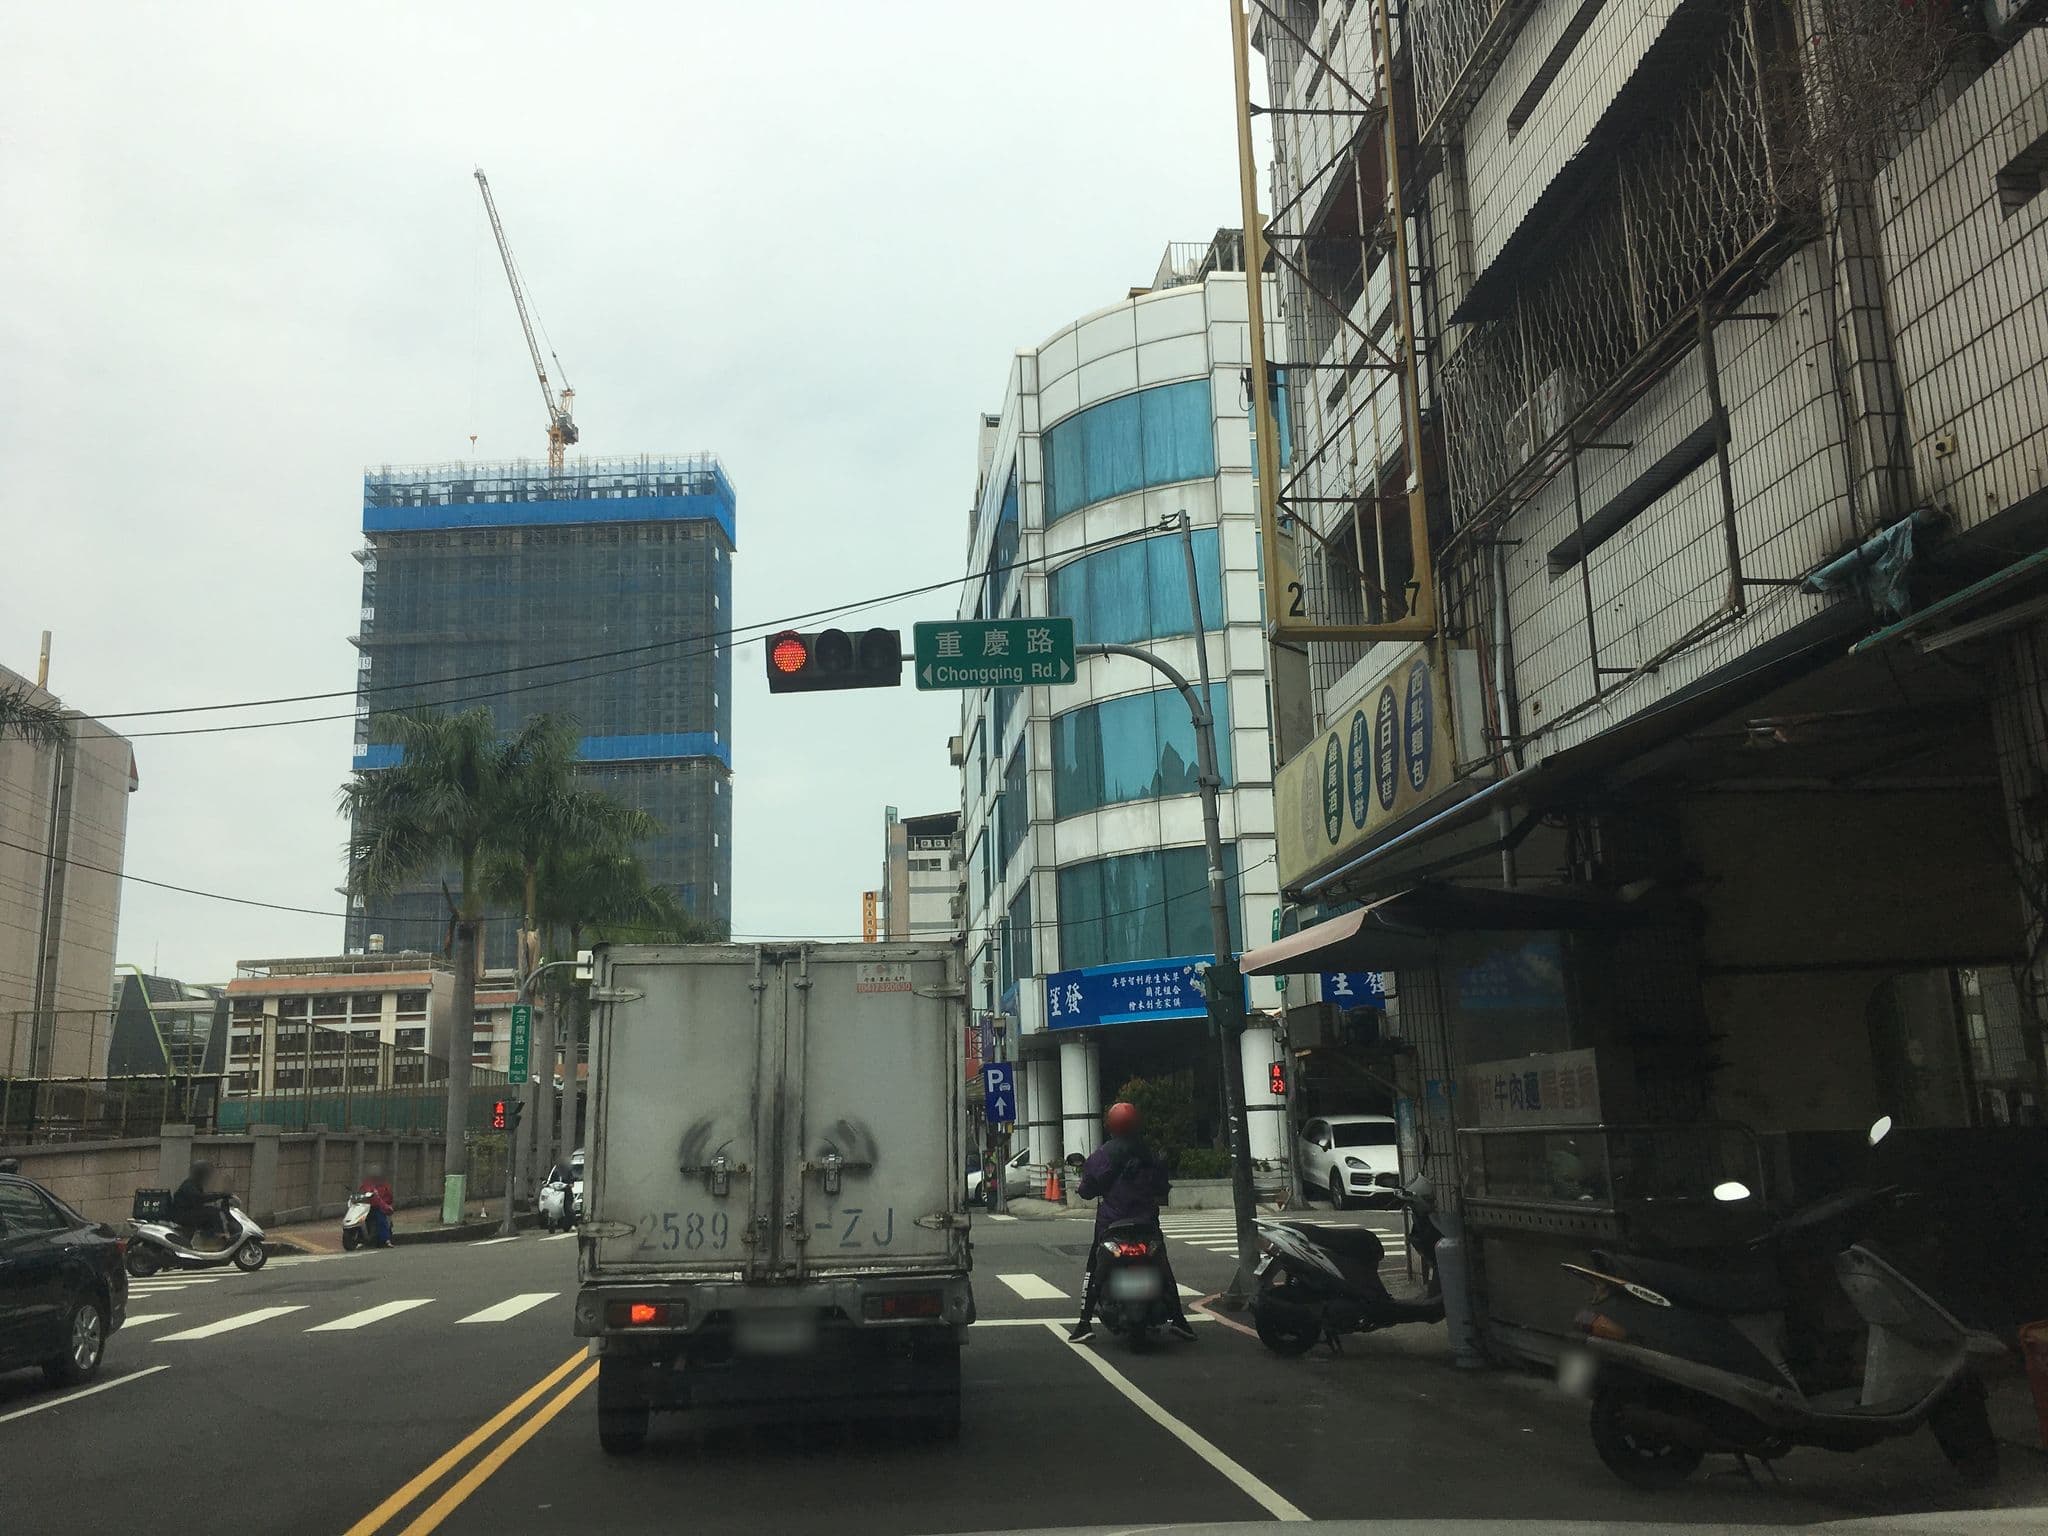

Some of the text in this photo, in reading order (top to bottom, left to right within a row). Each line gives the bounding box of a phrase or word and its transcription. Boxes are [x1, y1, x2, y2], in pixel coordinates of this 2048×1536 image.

[361, 609, 374, 620] 21
[936, 629, 1054, 657] 重慶路
[360, 658, 372, 670] 19
[937, 663, 1056, 683] Chongqing Rd.
[1381, 694, 1392, 803] 生日蛋糕
[987, 1069, 1004, 1093] P
[1272, 1080, 1284, 1093] 23
[638, 1212, 728, 1251] 2589
